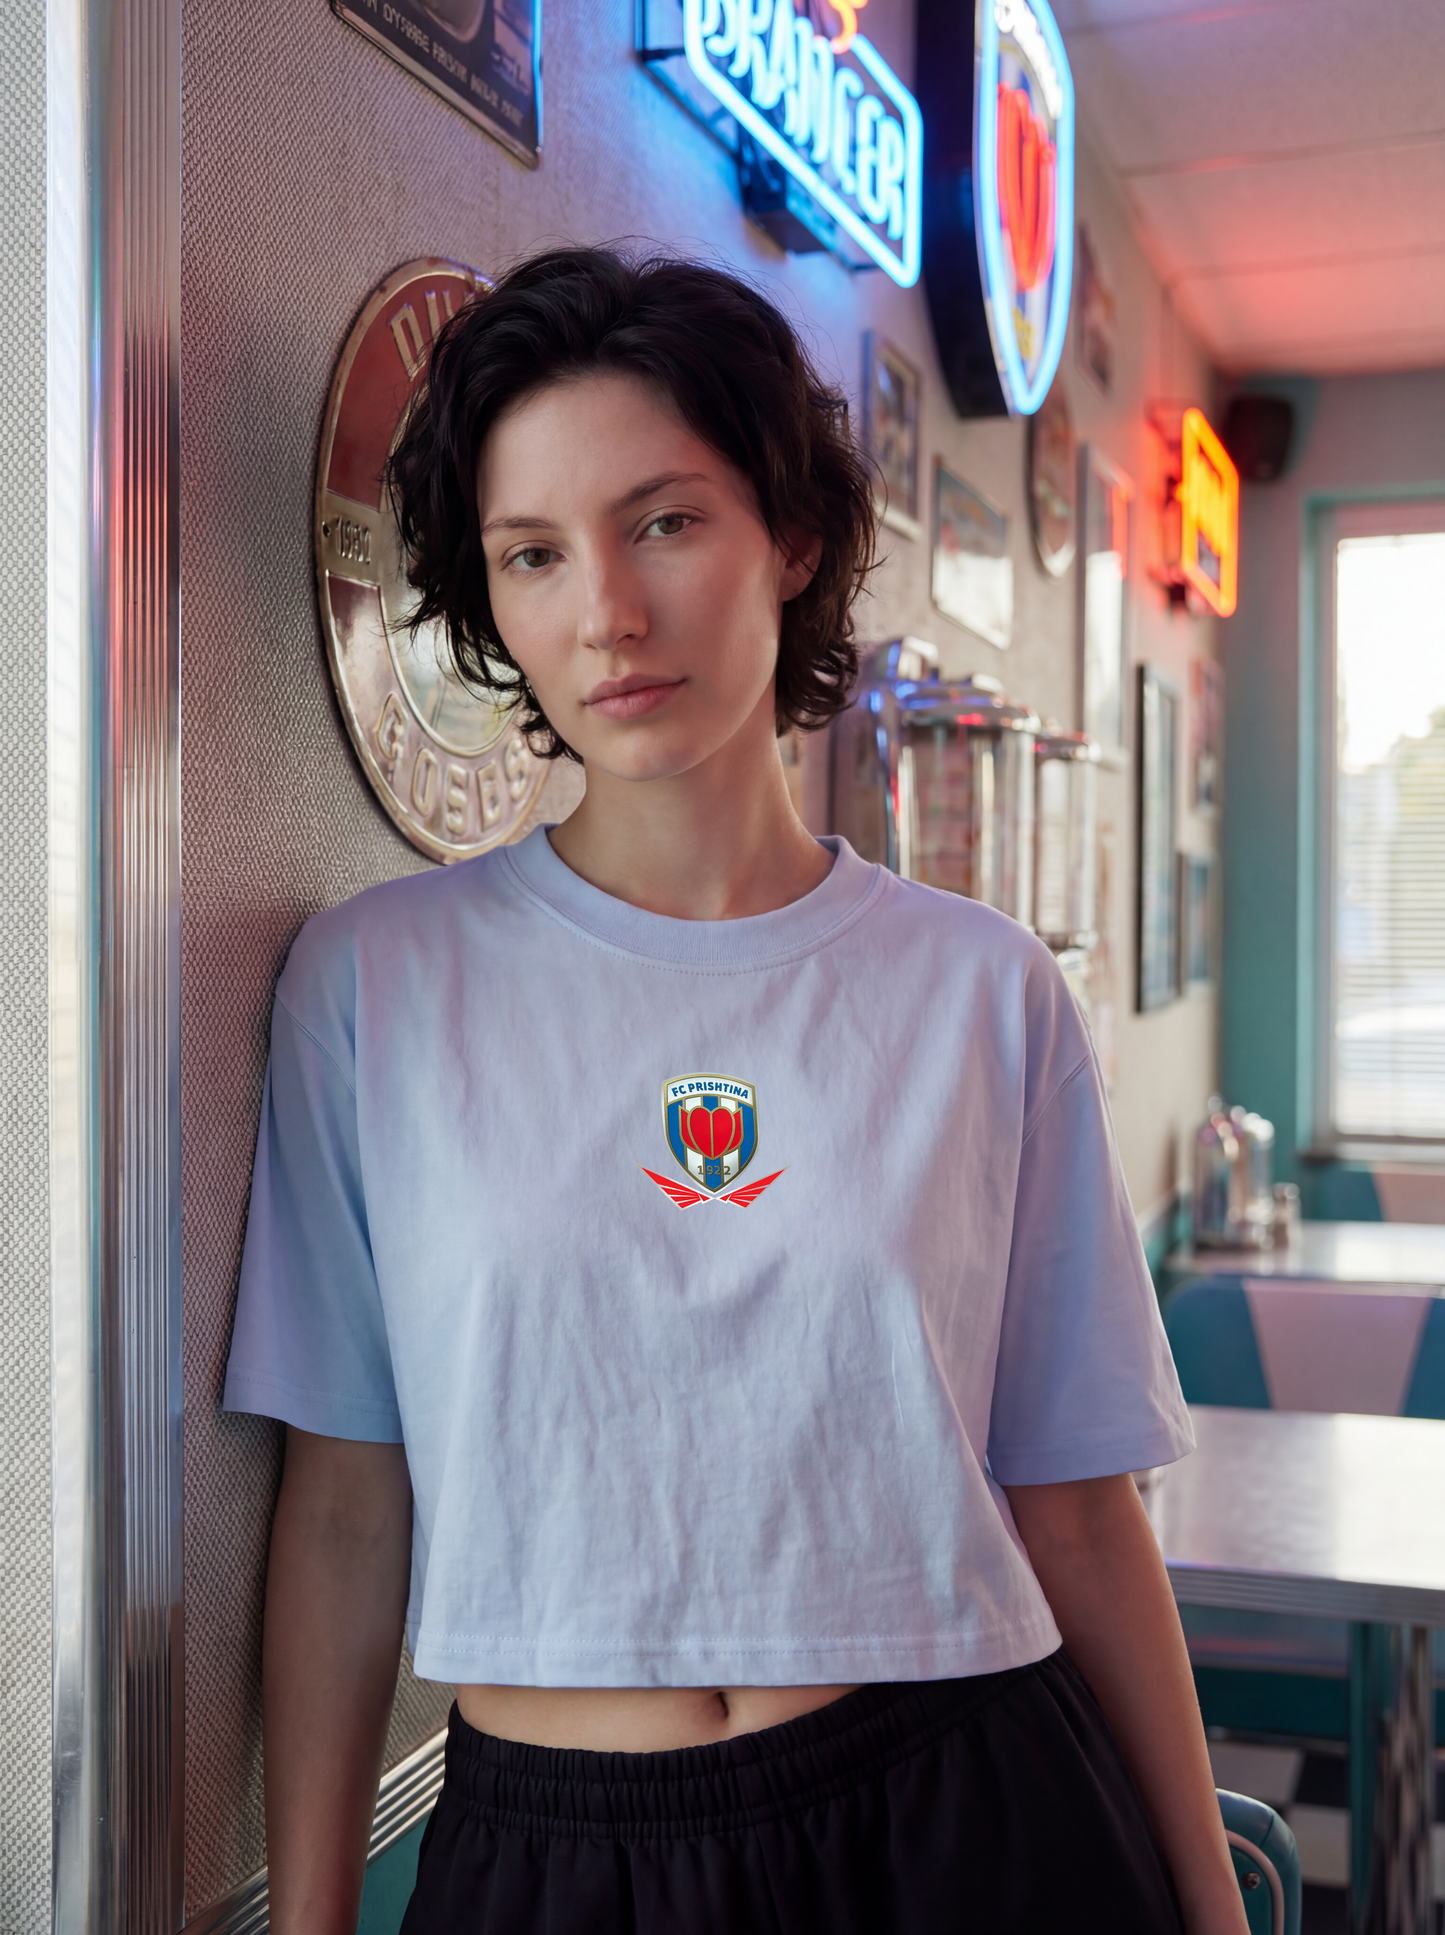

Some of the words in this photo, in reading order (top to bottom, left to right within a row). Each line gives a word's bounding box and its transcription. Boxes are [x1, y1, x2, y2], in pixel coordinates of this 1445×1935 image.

[671, 1084, 687, 1097] FC
[688, 1081, 749, 1099] PRISHTINA
[697, 1165, 731, 1176] 1922
